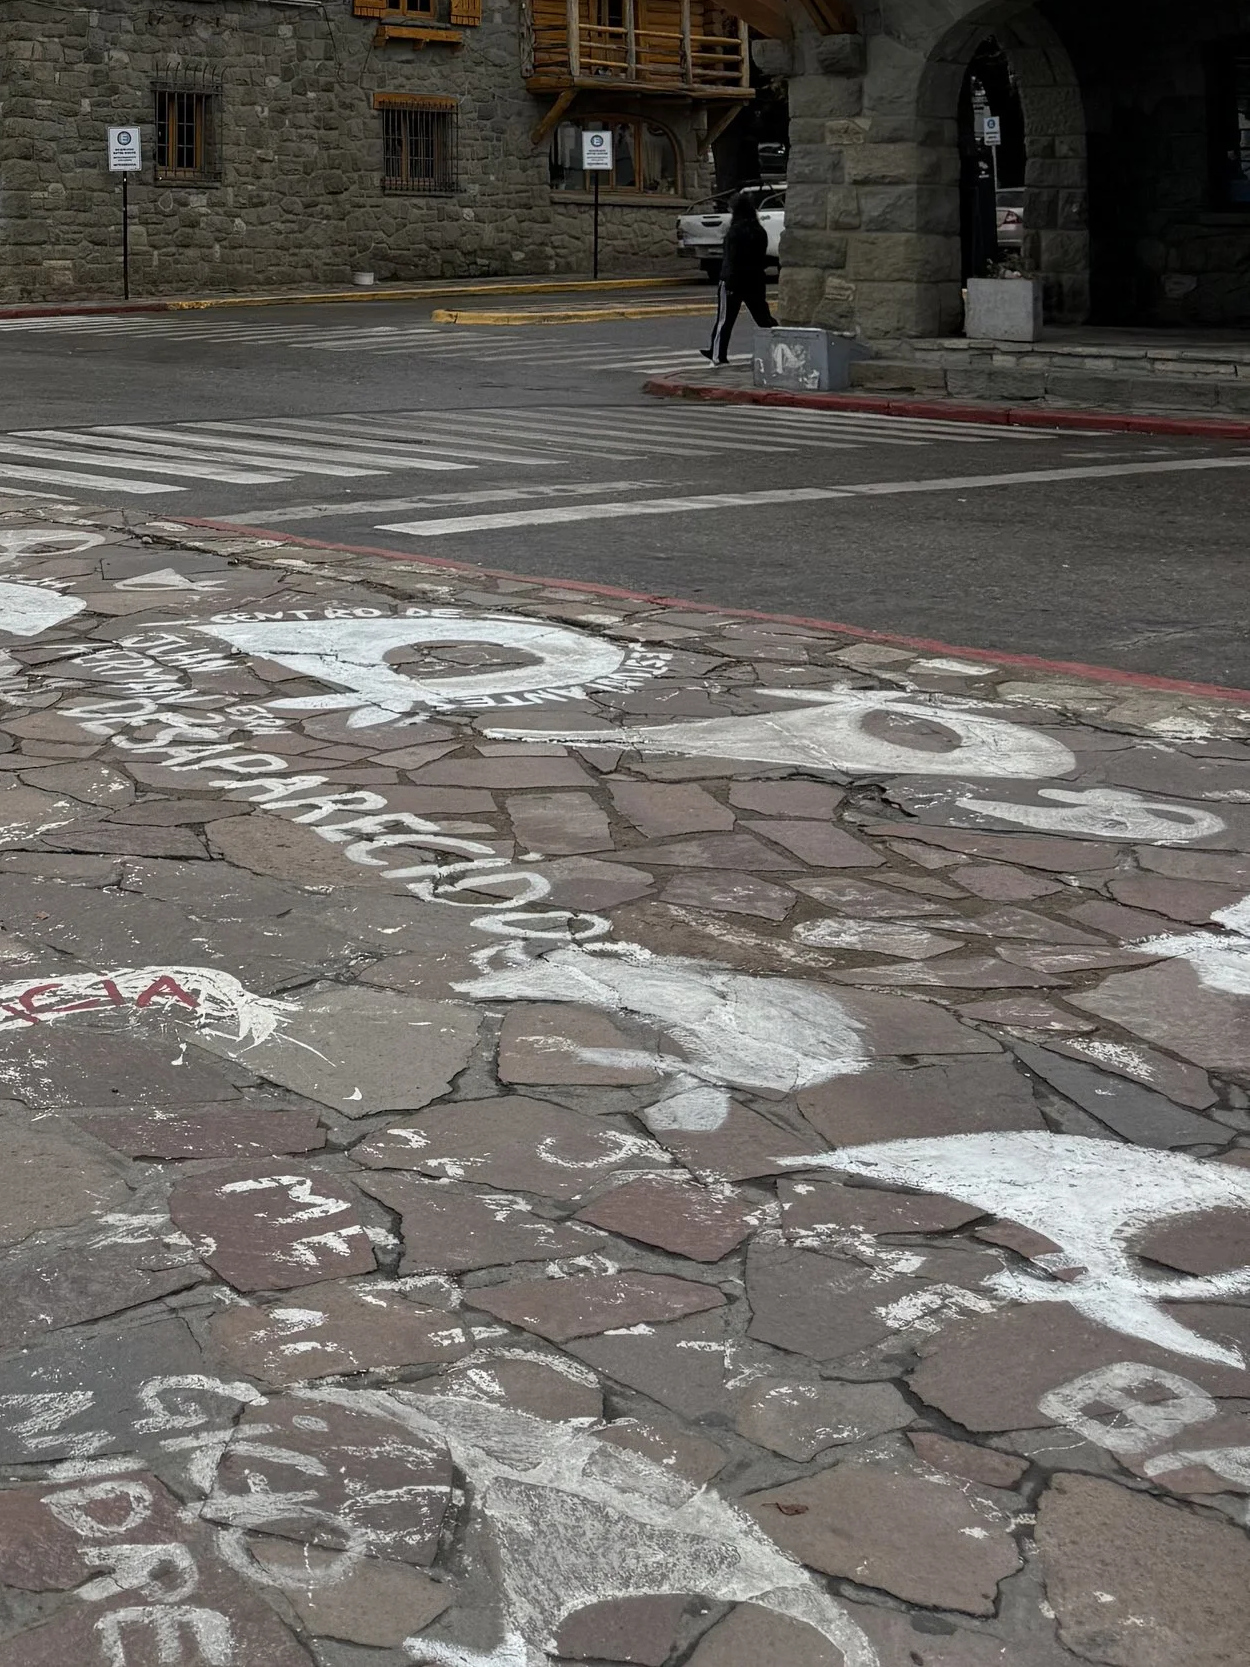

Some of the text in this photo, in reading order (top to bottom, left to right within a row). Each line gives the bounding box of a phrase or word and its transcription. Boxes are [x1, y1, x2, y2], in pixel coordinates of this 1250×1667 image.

[209, 608, 381, 624] CENTRO
[404, 607, 461, 618] DE
[56, 697, 613, 940] DESAPARECIDO
